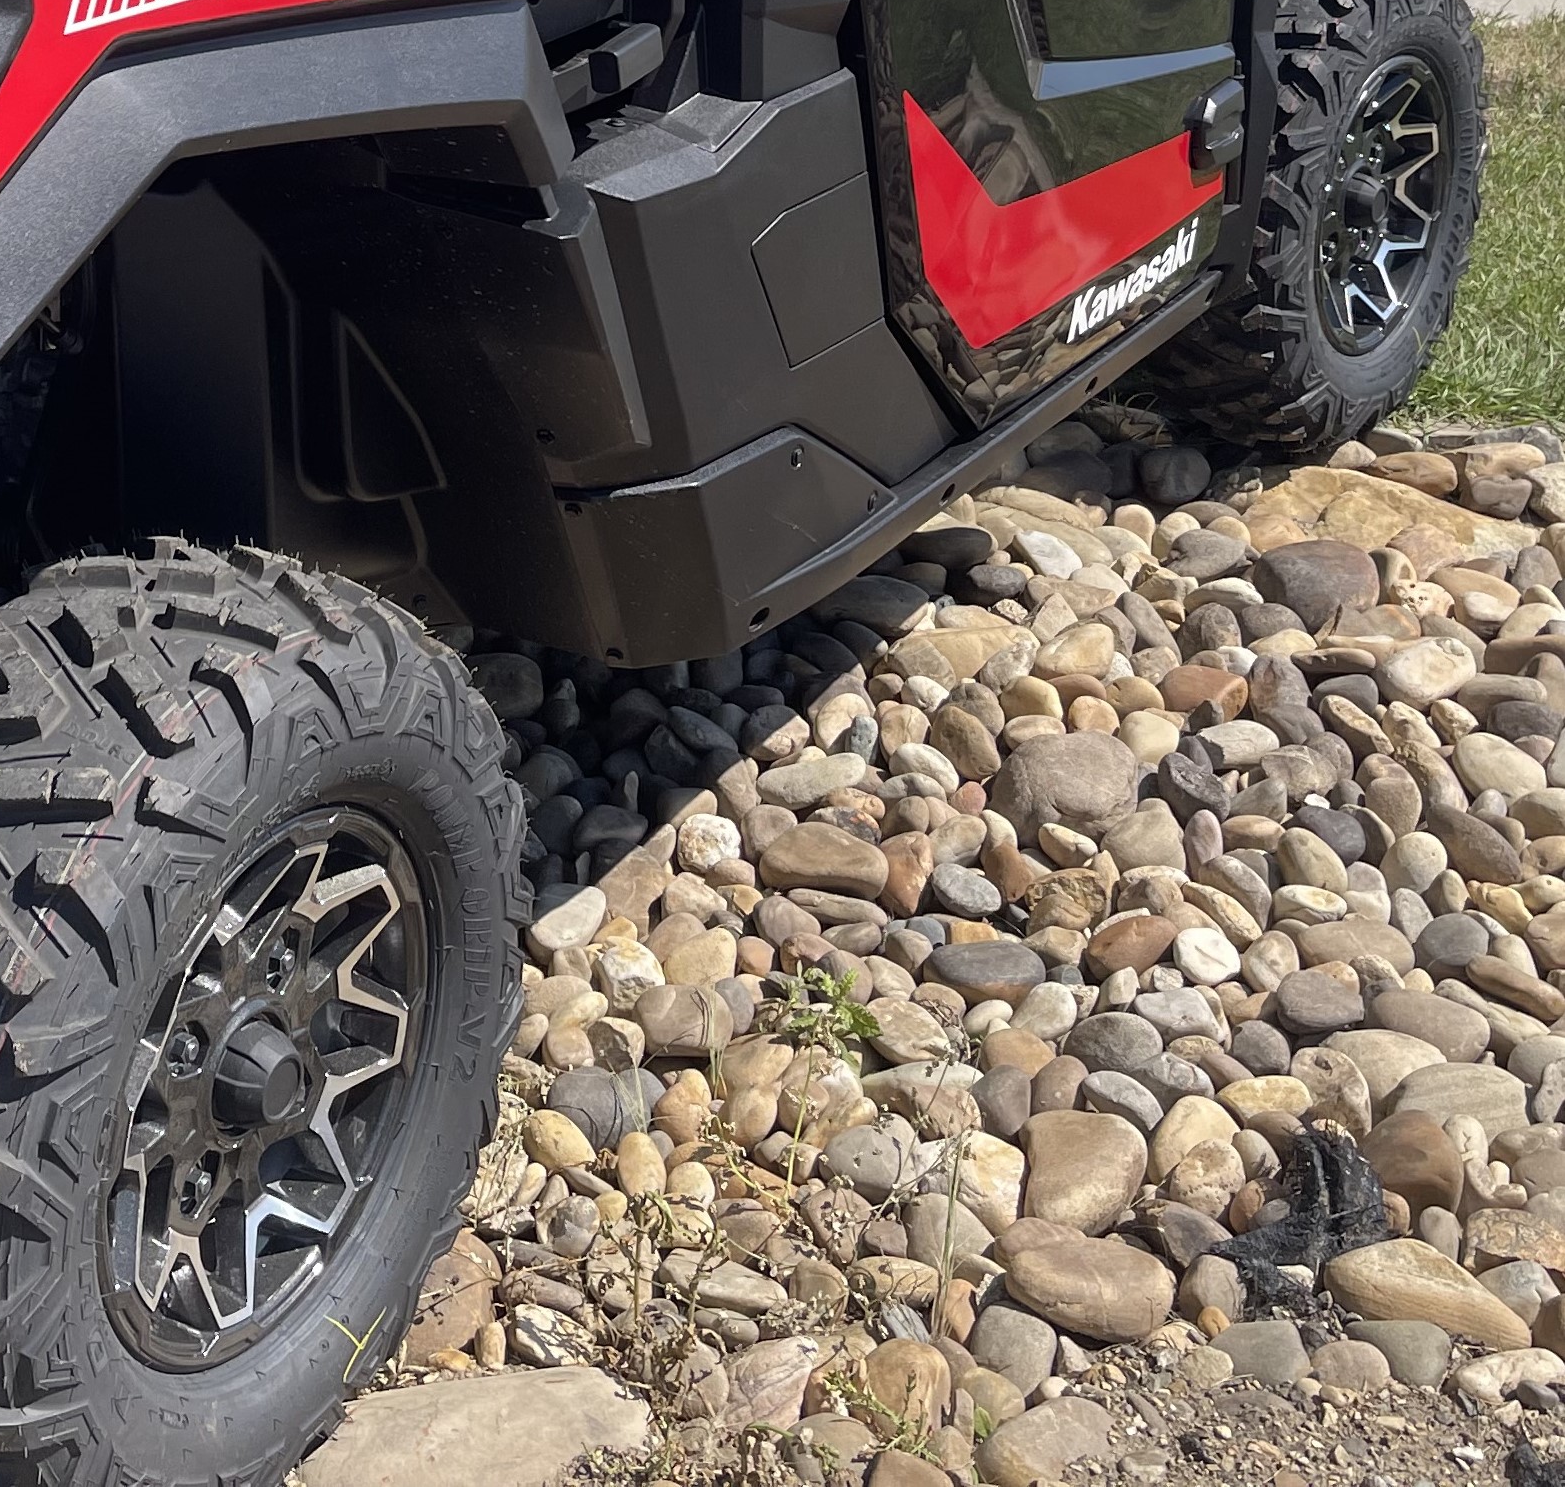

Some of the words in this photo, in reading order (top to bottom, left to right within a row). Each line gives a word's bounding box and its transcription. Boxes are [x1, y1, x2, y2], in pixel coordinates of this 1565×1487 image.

[1456, 110, 1475, 205] POWER
[1066, 216, 1200, 344] Kawasaki
[1439, 213, 1465, 283] GRIP
[406, 765, 484, 878] POWER
[460, 887, 494, 998] GRIP
